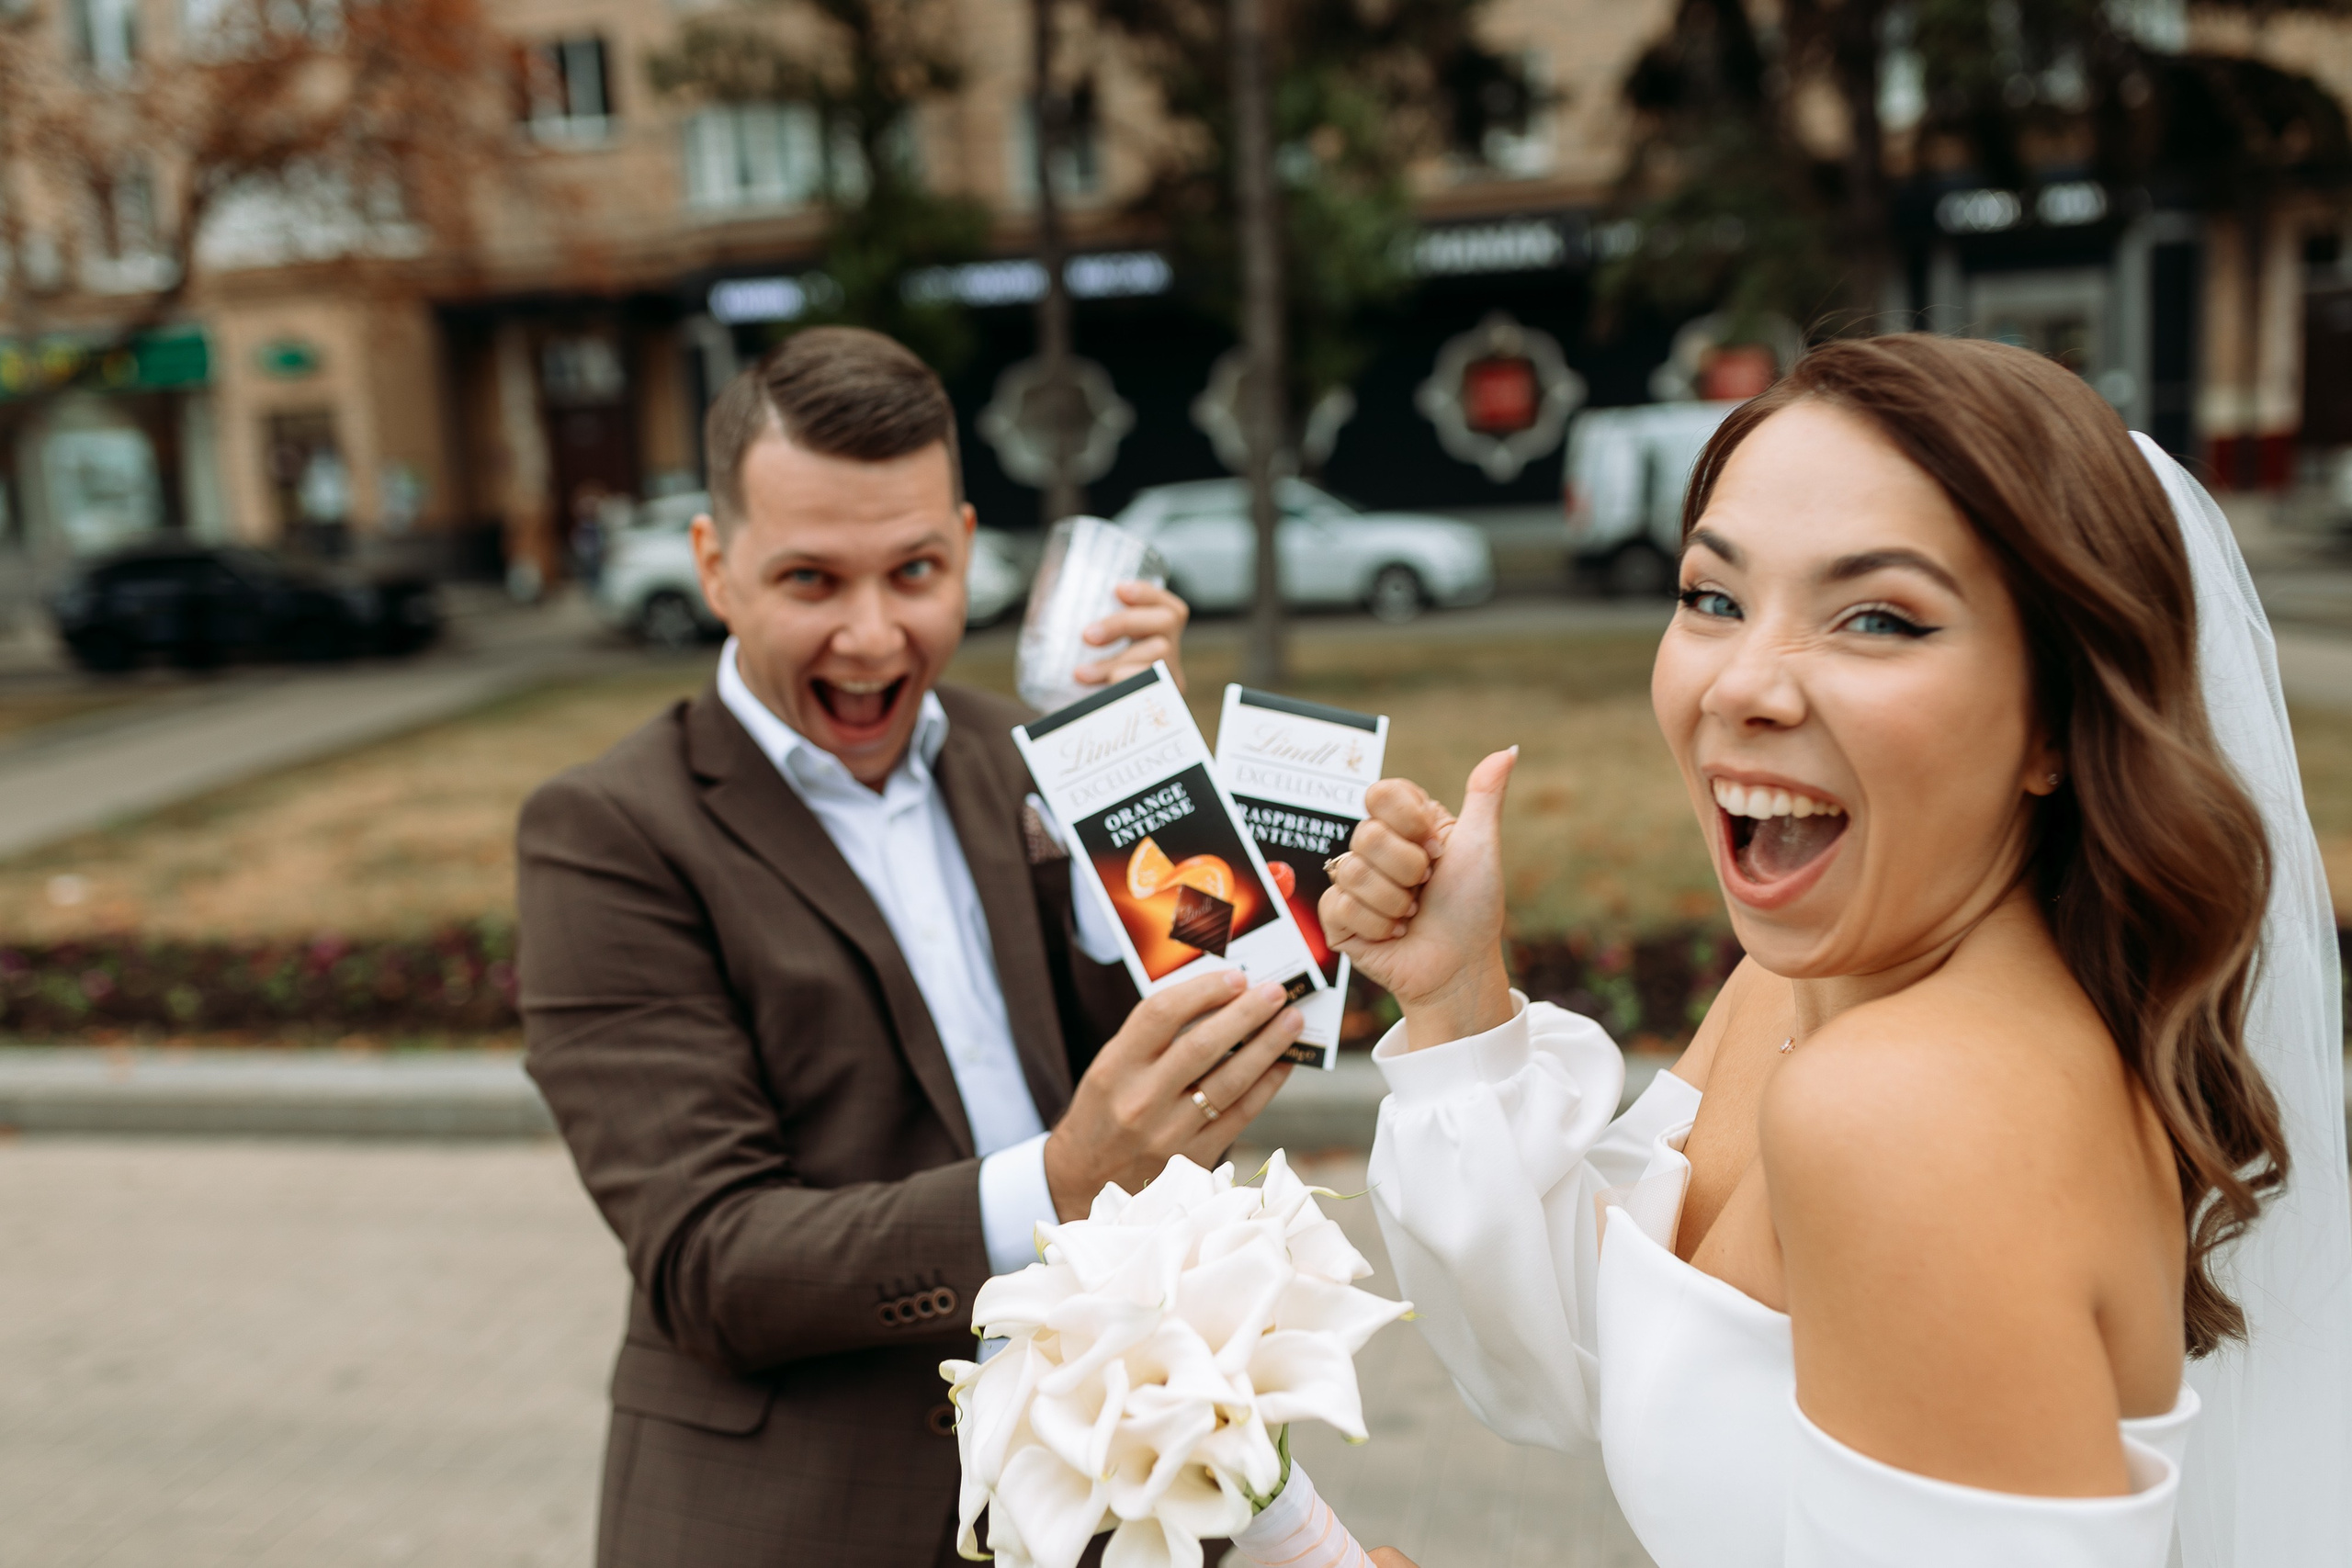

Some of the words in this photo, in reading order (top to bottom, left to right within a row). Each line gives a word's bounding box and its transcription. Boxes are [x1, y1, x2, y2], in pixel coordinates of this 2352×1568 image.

[1059, 711, 1140, 776] Lindt
[1243, 722, 1341, 765] Lindt
[1069, 739, 1188, 808] EXCELLENCE
[1236, 763, 1357, 806] EXCELLENCE
[1103, 782, 1188, 831] ORANGE
[1110, 796, 1195, 849] INTENSE
